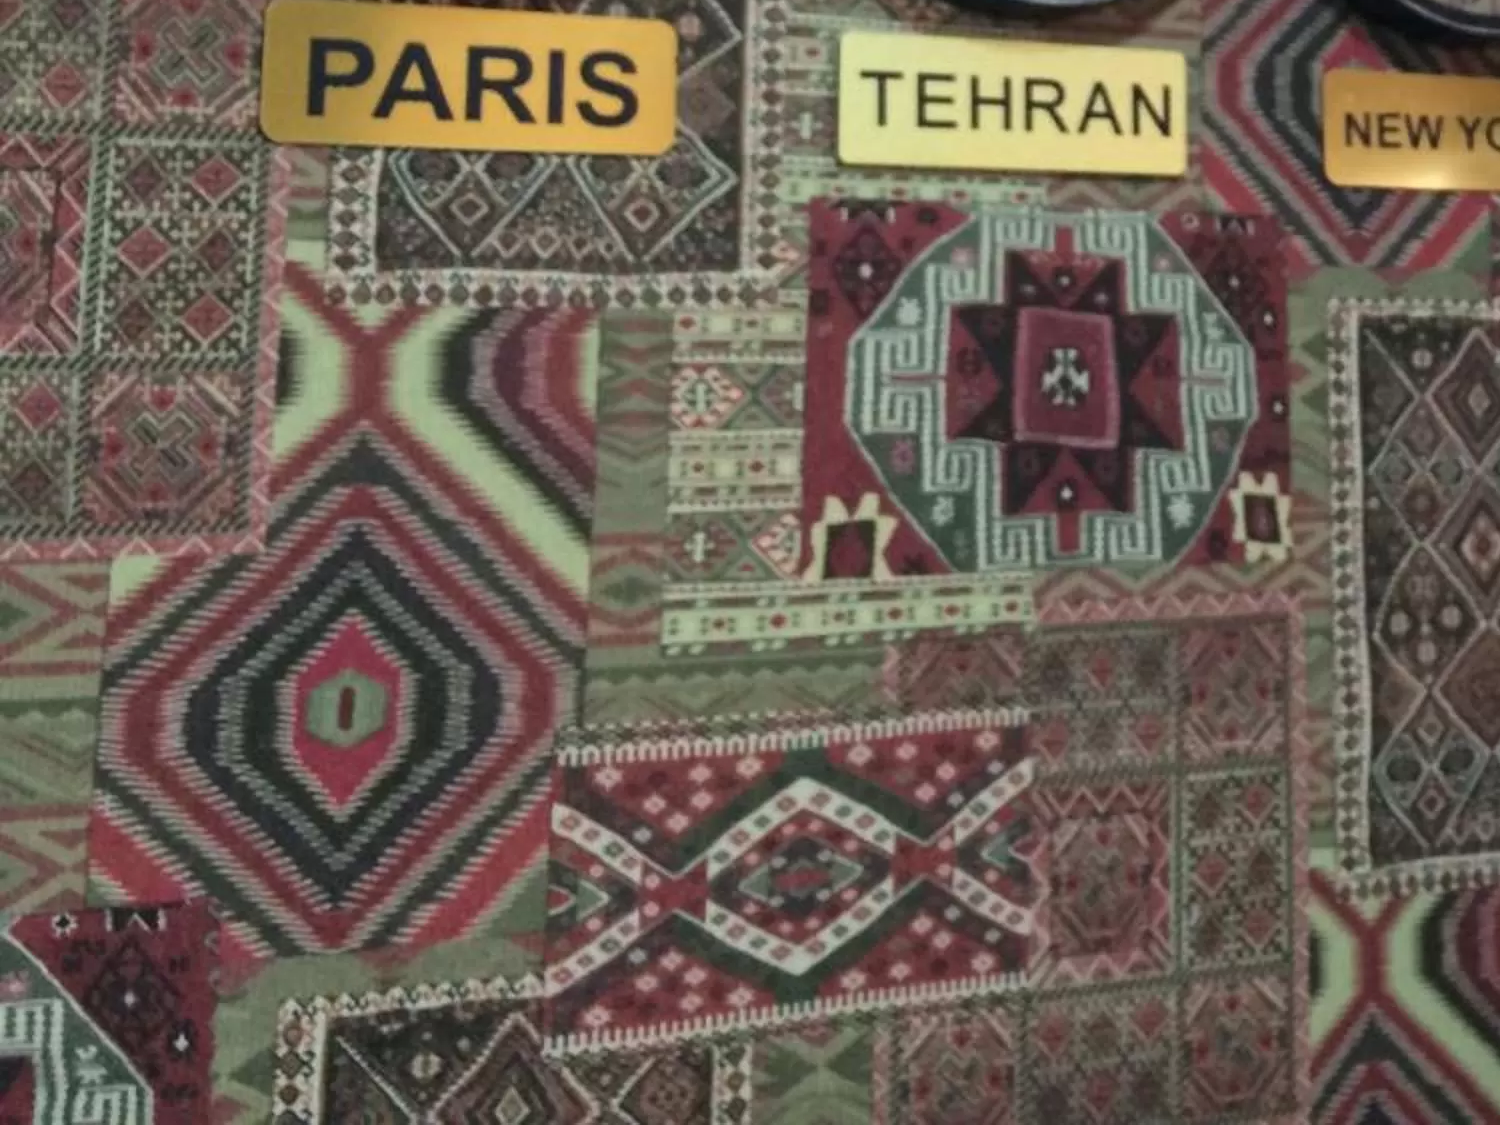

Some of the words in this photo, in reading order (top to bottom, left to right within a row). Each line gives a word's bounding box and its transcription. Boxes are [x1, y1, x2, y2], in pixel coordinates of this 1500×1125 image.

[306, 36, 640, 127] PARIS
[859, 70, 1172, 137] TEHRAN
[1344, 112, 1445, 150] NEW
